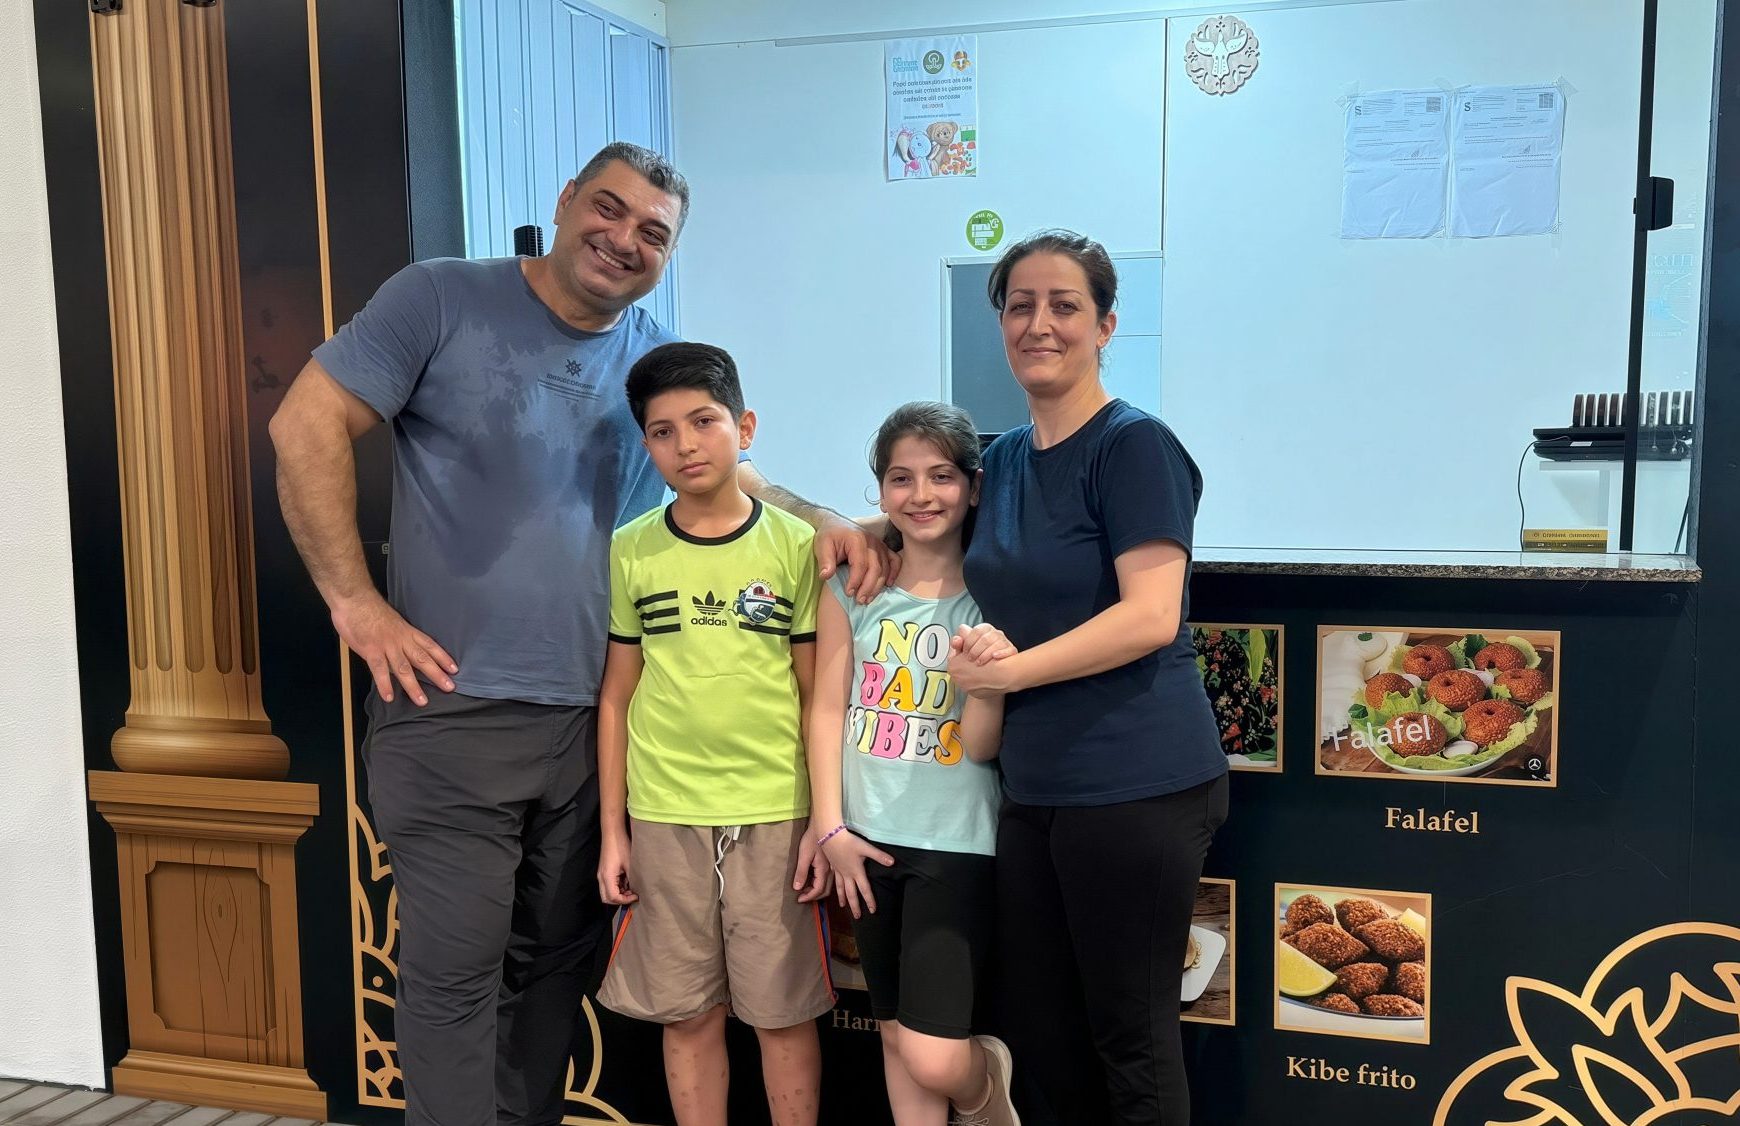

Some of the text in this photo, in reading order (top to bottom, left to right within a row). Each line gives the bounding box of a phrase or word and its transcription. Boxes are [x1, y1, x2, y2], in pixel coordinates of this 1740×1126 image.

[691, 616, 727, 627] adidas
[873, 619, 950, 668] NO
[860, 661, 955, 716] BAD
[846, 704, 963, 766] VIBES
[1333, 715, 1432, 752] Falafel
[1385, 807, 1480, 834] Falafel
[1286, 1056, 1417, 1090] Kibe frito
